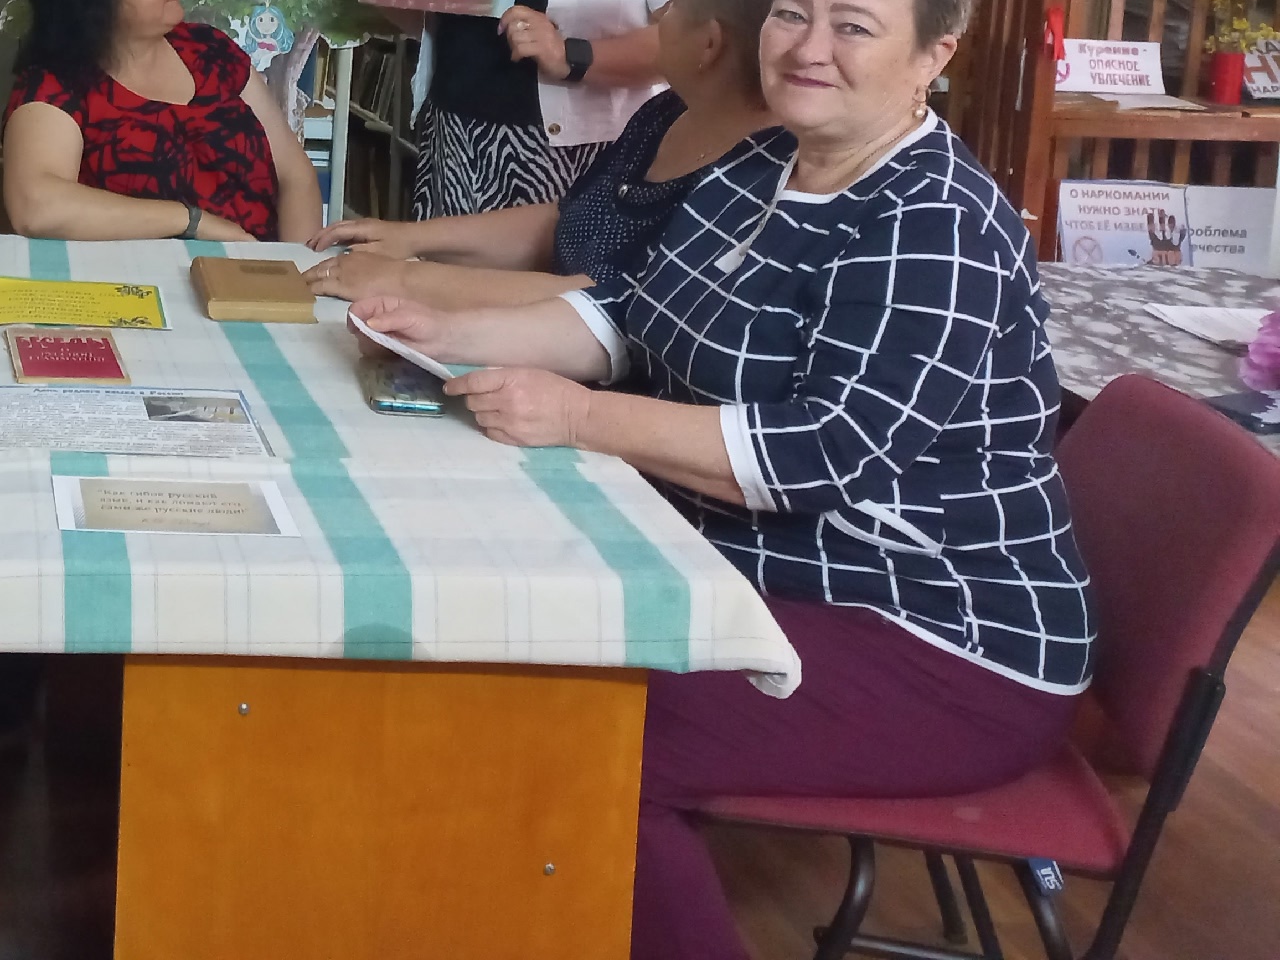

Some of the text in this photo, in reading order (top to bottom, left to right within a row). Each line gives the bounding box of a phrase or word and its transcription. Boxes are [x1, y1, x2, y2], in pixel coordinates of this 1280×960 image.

[1078, 42, 1139, 58] Курение
[1089, 59, 1140, 72] ОПАСНОЕ
[1090, 72, 1152, 87] УВЛЕЧЕНИЕ
[1069, 188, 1170, 201] О НАРКОМАНИИ
[1078, 204, 1121, 216] НУЖНО
[1064, 220, 1096, 231] ЧТОБ
[1097, 219, 1111, 231] ЕЁ
[1188, 225, 1248, 239] роблема
[1190, 243, 1246, 255] ечества
